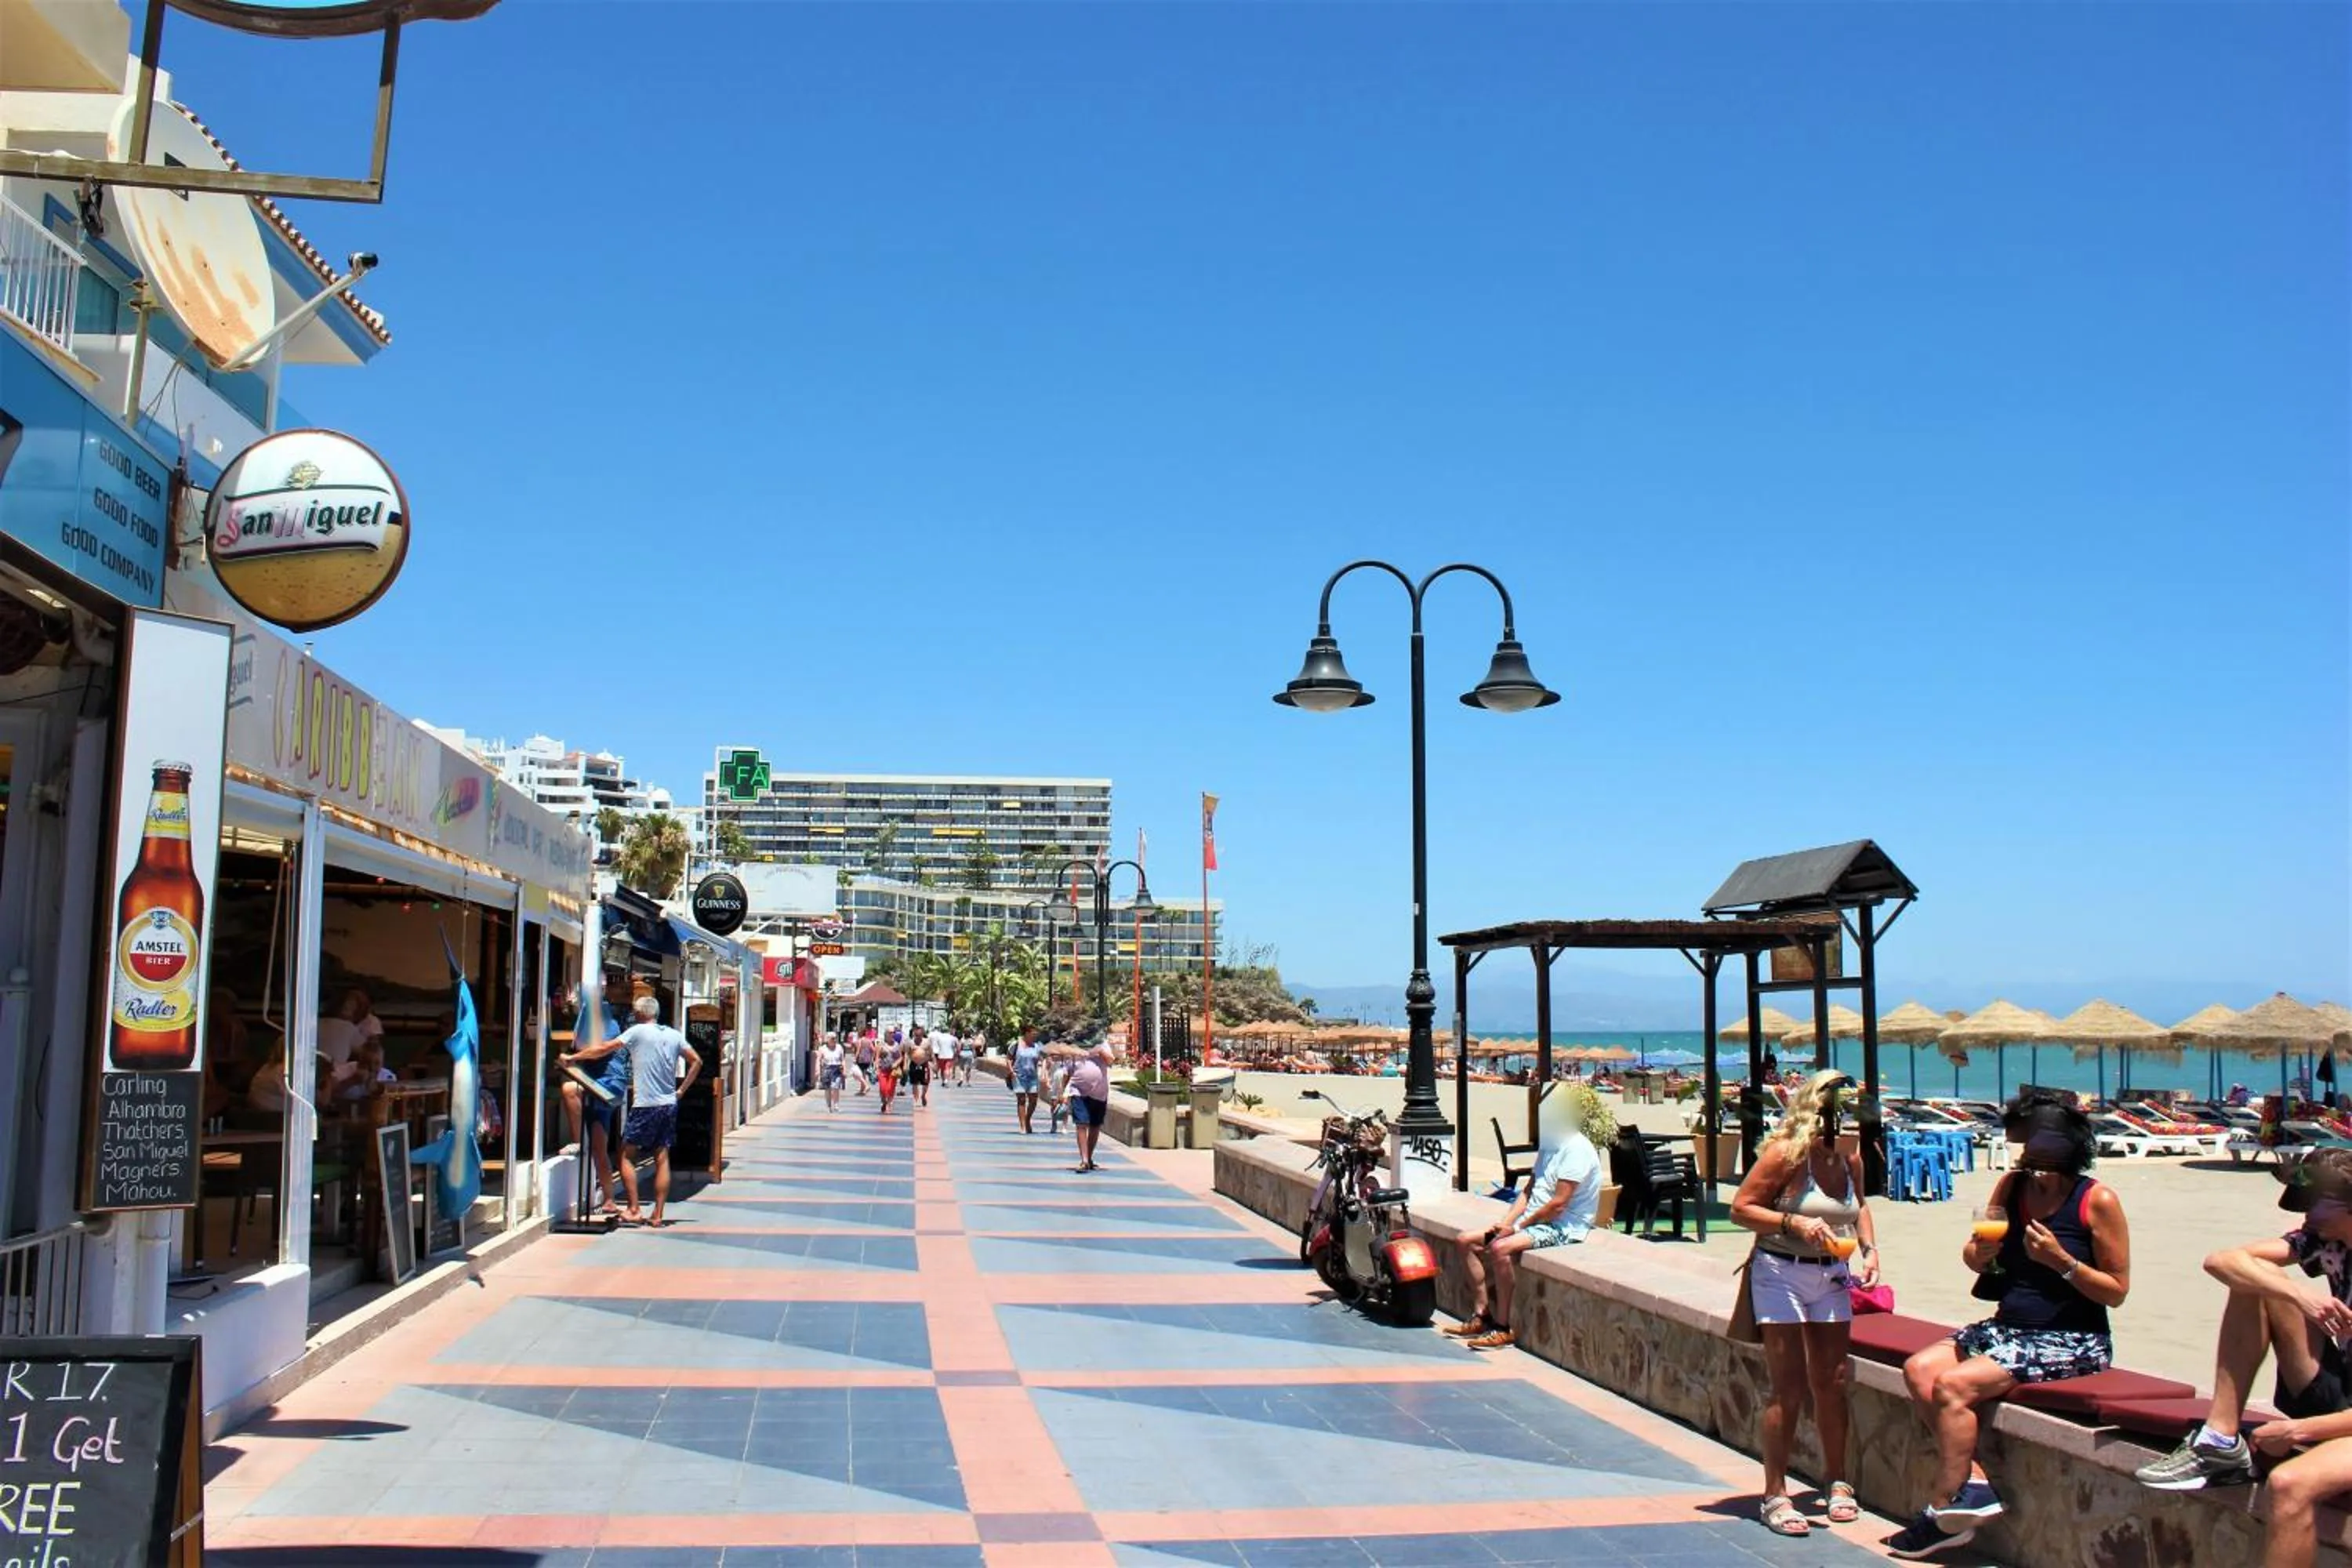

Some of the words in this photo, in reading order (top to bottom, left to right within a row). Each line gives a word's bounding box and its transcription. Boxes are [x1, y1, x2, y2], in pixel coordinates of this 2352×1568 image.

[100, 437, 132, 479] GOOD
[135, 466, 161, 501] BEER
[94, 487, 128, 527] GOOD
[130, 514, 158, 548] FOOD
[62, 521, 97, 557] GOOD
[101, 544, 155, 595] COMPANY
[738, 766, 767, 787] FA
[697, 898, 741, 910] GUINNESS
[136, 941, 182, 953] AMSTEL
[813, 946, 840, 954] OPEN
[125, 997, 176, 1022] Radler
[102, 1072, 167, 1097] Carling
[107, 1098, 186, 1119] Alhambra
[103, 1142, 136, 1160] San
[140, 1141, 188, 1164] Miguel
[4, 1412, 28, 1462] 1
[52, 1416, 125, 1472] Get
